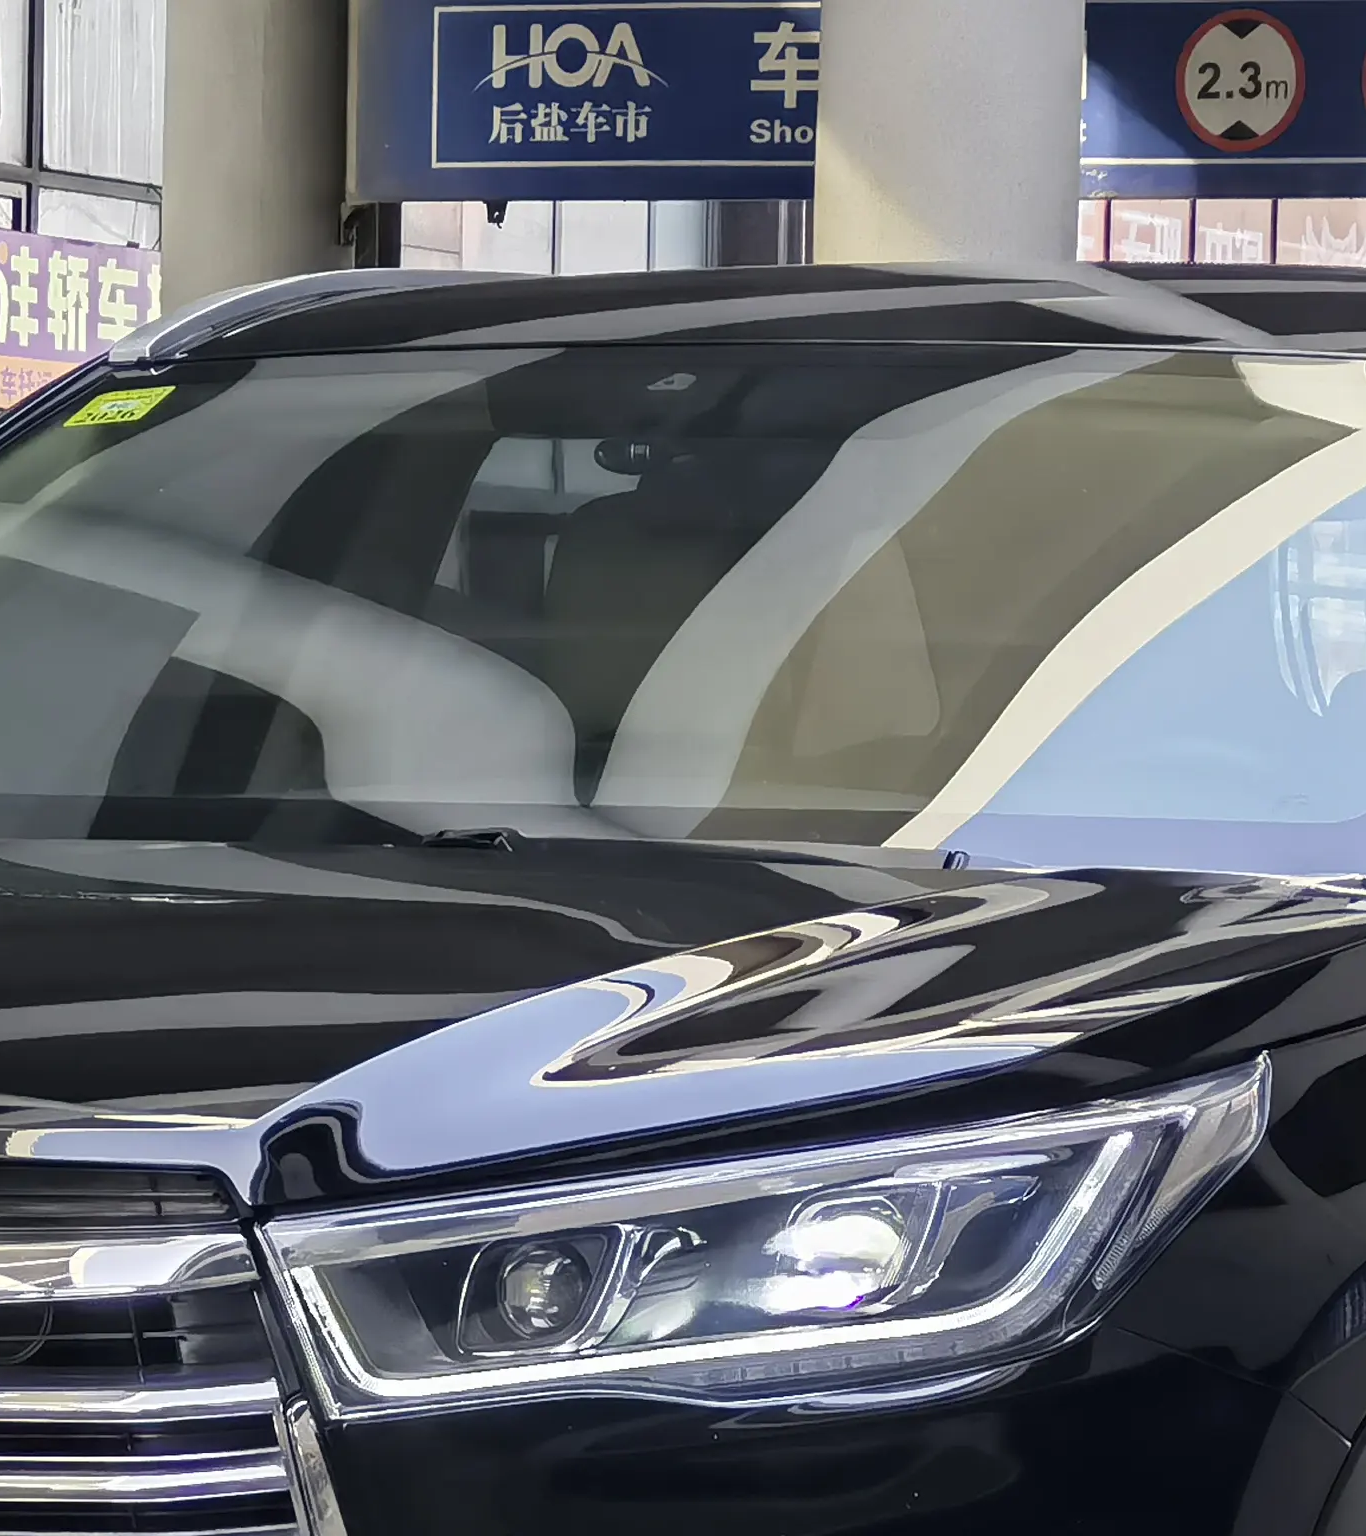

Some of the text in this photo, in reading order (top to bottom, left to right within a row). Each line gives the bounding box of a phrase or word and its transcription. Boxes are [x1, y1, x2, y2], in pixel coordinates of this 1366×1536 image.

[492, 22, 651, 89] HOA
[489, 102, 653, 144] 后盐车市
